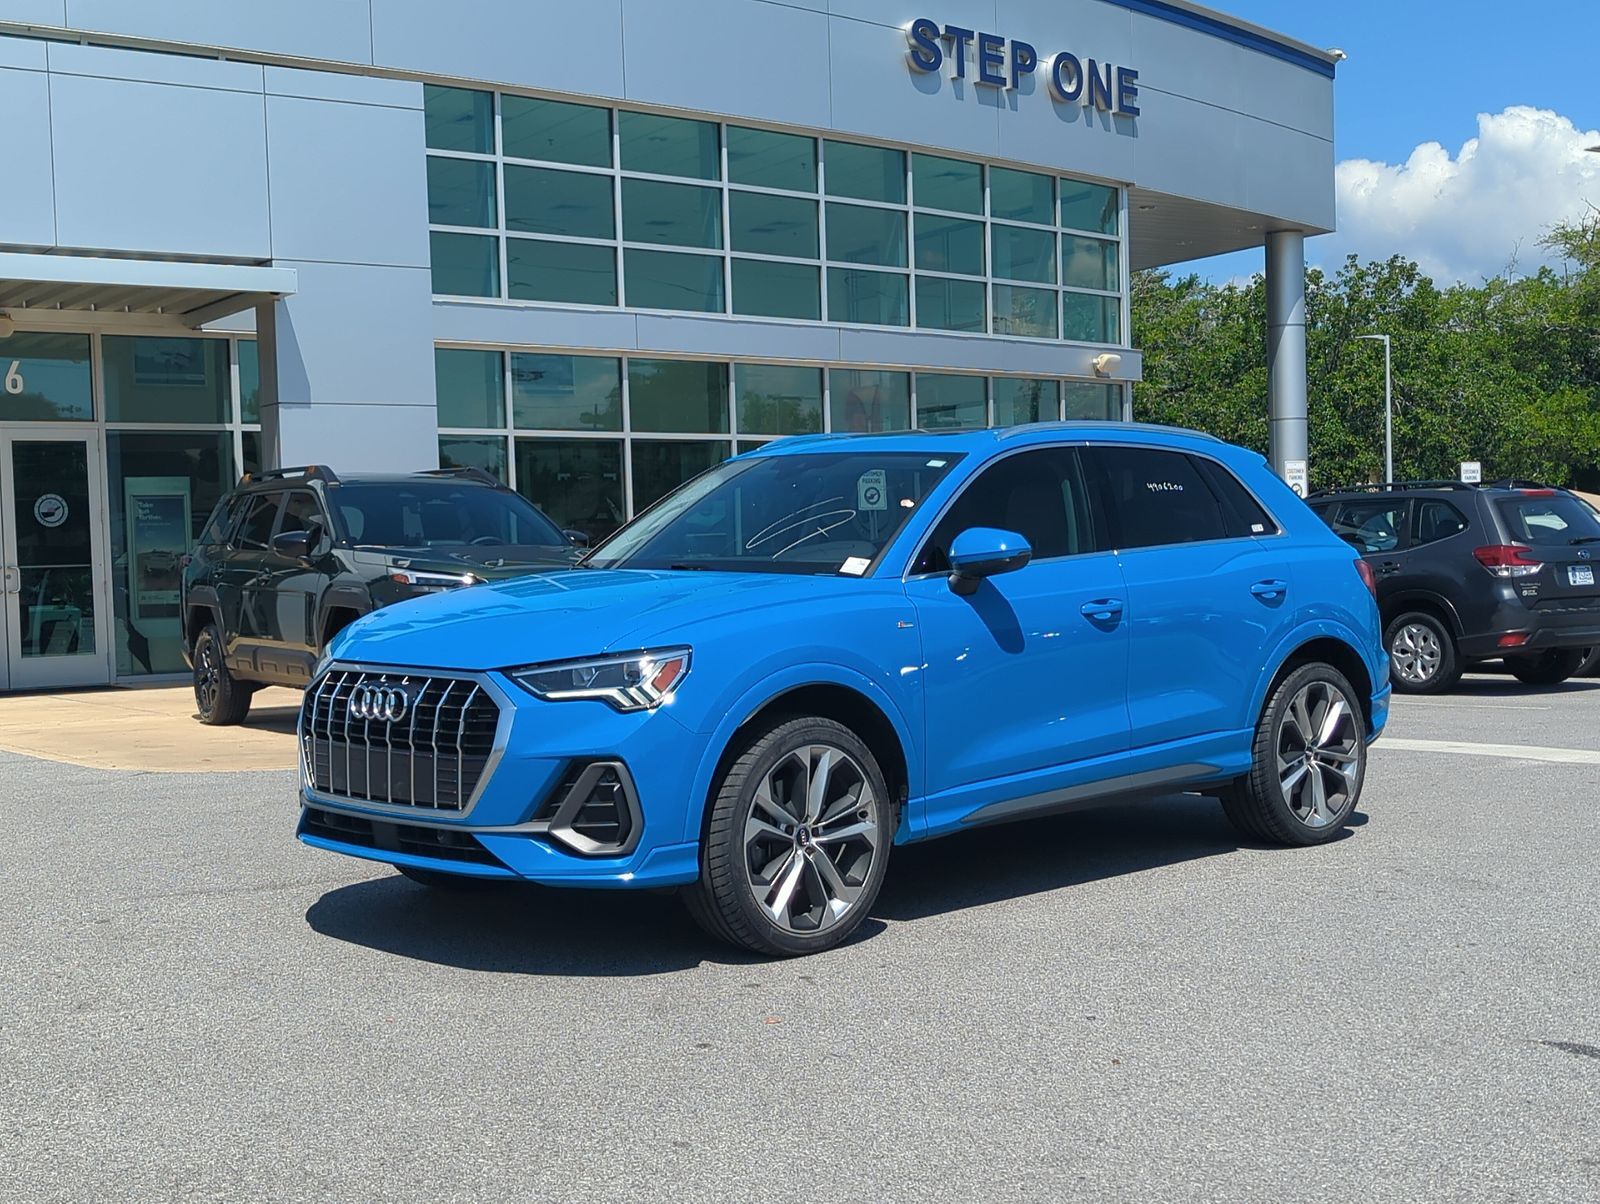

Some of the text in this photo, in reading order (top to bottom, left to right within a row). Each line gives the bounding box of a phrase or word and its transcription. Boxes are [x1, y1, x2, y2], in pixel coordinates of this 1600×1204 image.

[905, 18, 1140, 117] STEP ONE
[5, 360, 24, 394] 6
